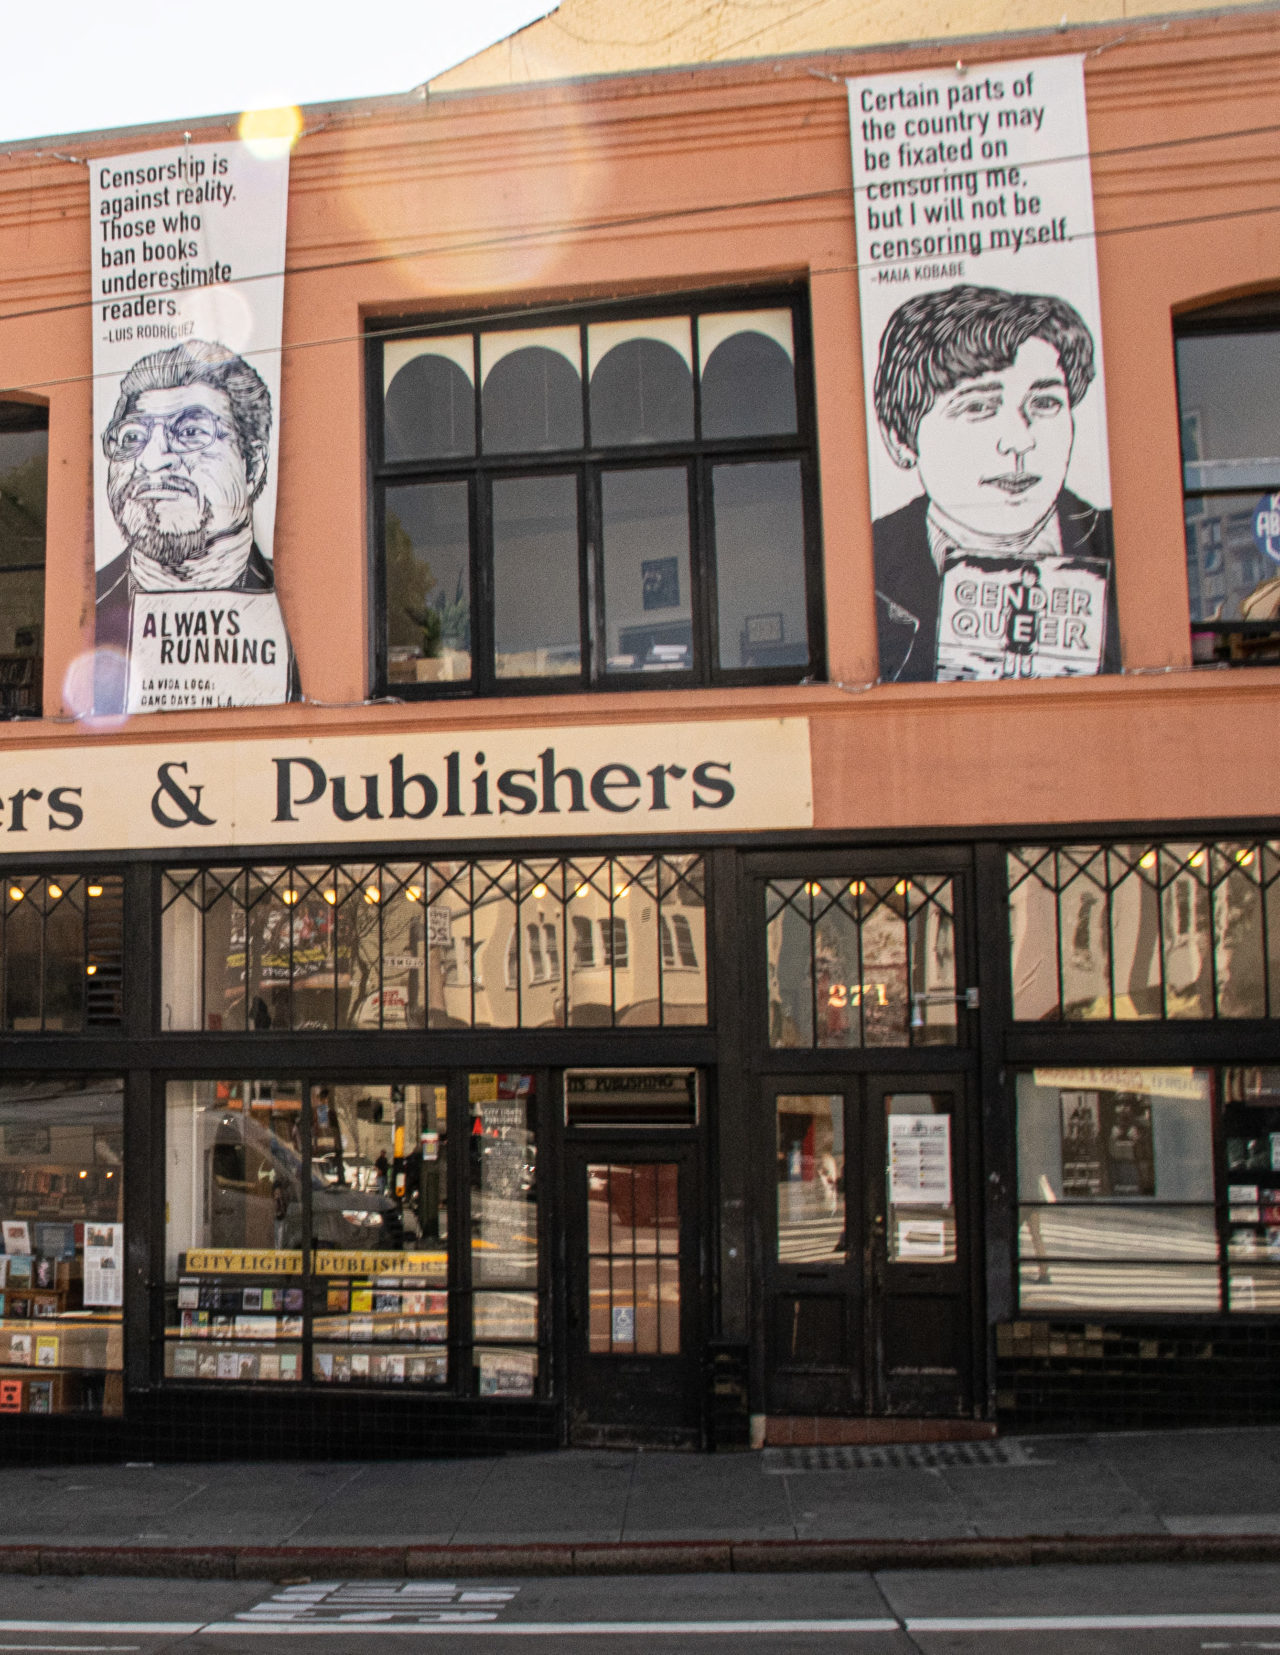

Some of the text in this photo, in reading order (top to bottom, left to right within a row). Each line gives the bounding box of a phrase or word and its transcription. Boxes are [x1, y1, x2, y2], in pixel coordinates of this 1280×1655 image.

[861, 72, 1034, 113] Certain parts of
[862, 105, 1045, 141] the country may
[864, 137, 1008, 171] be fixated on
[100, 153, 229, 190] Censorship is
[866, 168, 978, 201] censoring
[100, 180, 236, 219] against reality.
[868, 191, 1041, 231] but I will not be
[100, 211, 201, 242] Those who
[870, 216, 1075, 260] censoring myself.
[101, 238, 199, 268] ban books
[102, 261, 232, 295] underestimate
[914, 261, 965, 281] KOBABE
[102, 295, 182, 322] readers.
[955, 580, 1092, 617] GENDER
[143, 609, 241, 638] ALWAYS
[952, 608, 1089, 650] QUEER
[160, 638, 276, 665] RUNNING
[141, 695, 167, 706] GANG
[170, 695, 196, 706] DAYS
[201, 695, 213, 706] IN
[142, 679, 154, 690] LA
[158, 679, 180, 690] VIDA
[151, 761, 218, 829] &
[269, 746, 738, 823] Publishers
[827, 984, 889, 1008] 271
[189, 1256, 234, 1272] CITY
[241, 1257, 303, 1272] LIGHT
